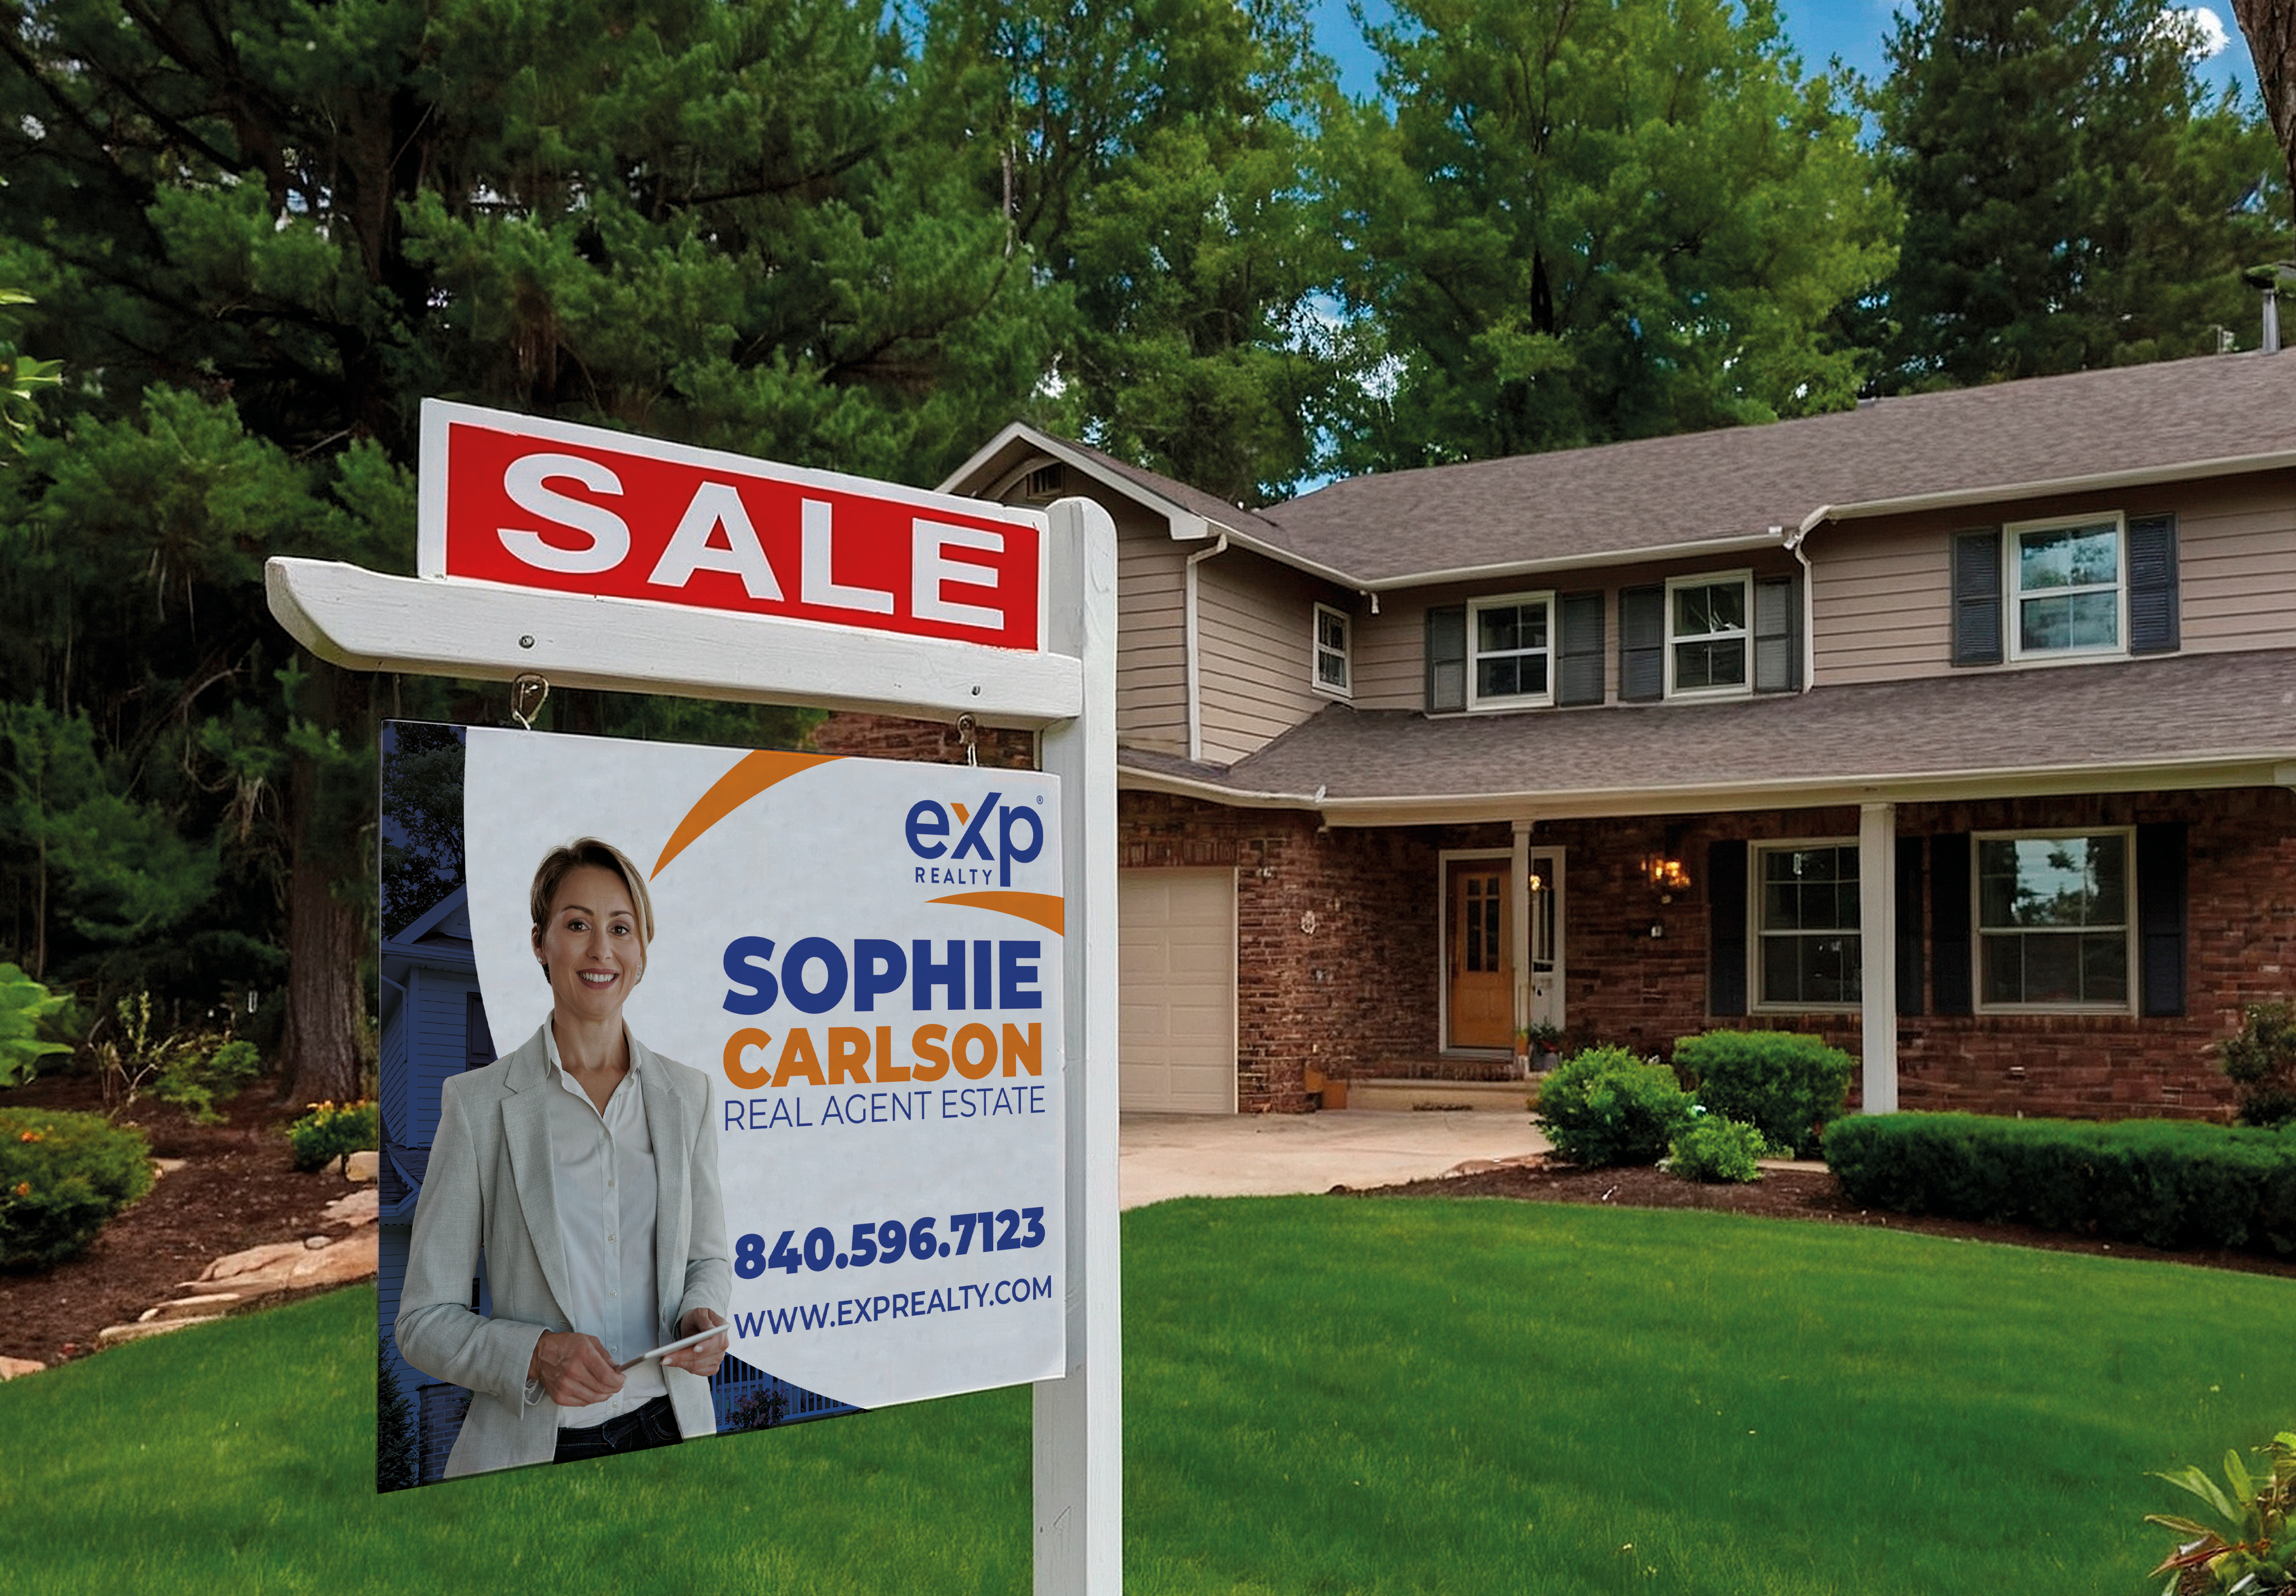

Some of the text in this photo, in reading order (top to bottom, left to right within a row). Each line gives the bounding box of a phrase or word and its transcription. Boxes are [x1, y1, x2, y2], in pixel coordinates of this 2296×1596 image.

[497, 453, 1004, 630] SALE
[915, 867, 992, 885] REALTY
[723, 936, 1042, 1015] SOPHIE
[723, 1023, 1042, 1089] CARLSON
[725, 1086, 1045, 1131] REAL AGENT ESTATE
[734, 1207, 1045, 1280] 840.596.7123
[734, 1275, 1052, 1339] WWW.EXPREALTY.COM
